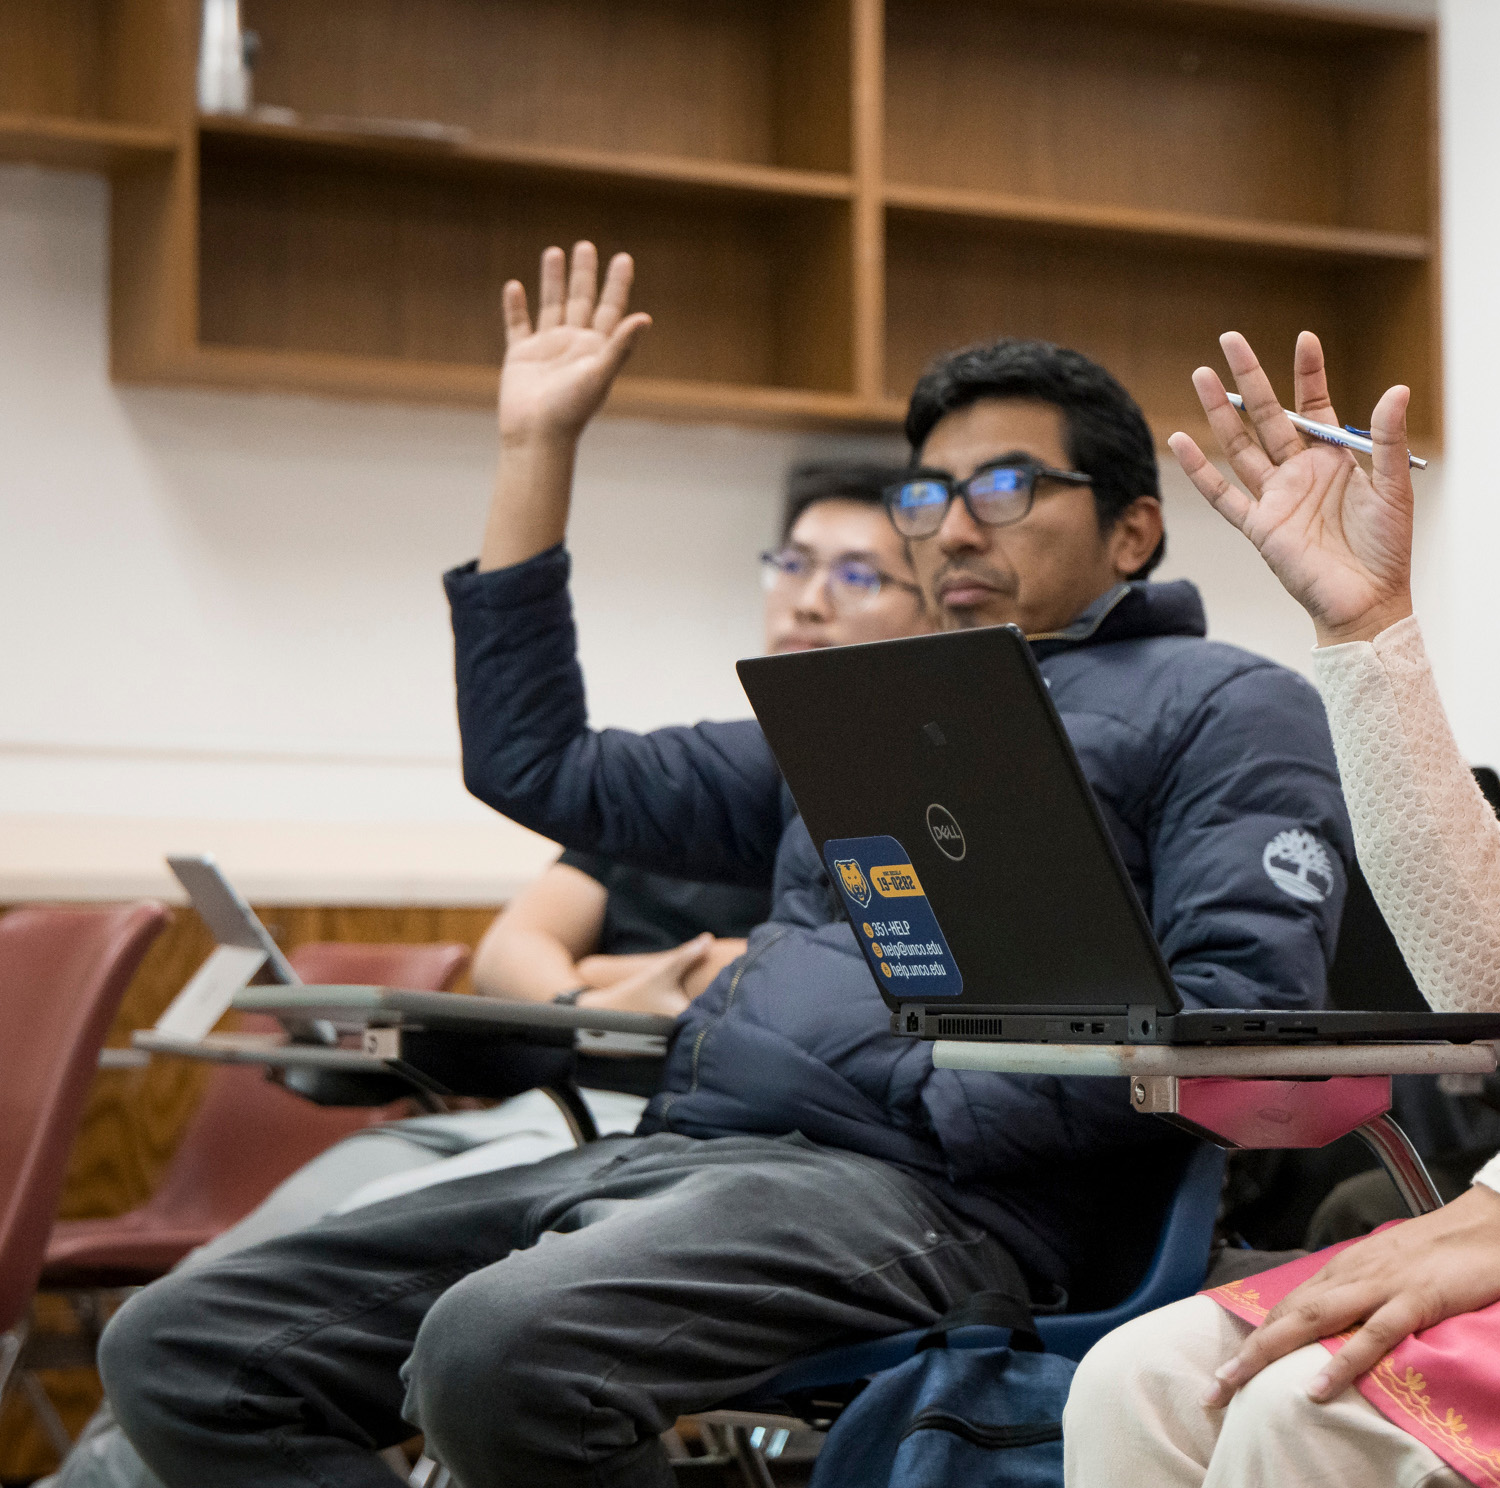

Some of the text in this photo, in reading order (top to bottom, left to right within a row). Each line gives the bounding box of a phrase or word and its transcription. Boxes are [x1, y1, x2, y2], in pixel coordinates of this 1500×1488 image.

[932, 825, 961, 841] DELL
[877, 875, 916, 891] 19-0282
[871, 920, 910, 937] 351-HELP
[880, 940, 943, 959] help@unco.edu
[889, 961, 947, 979] help.unco.edu
